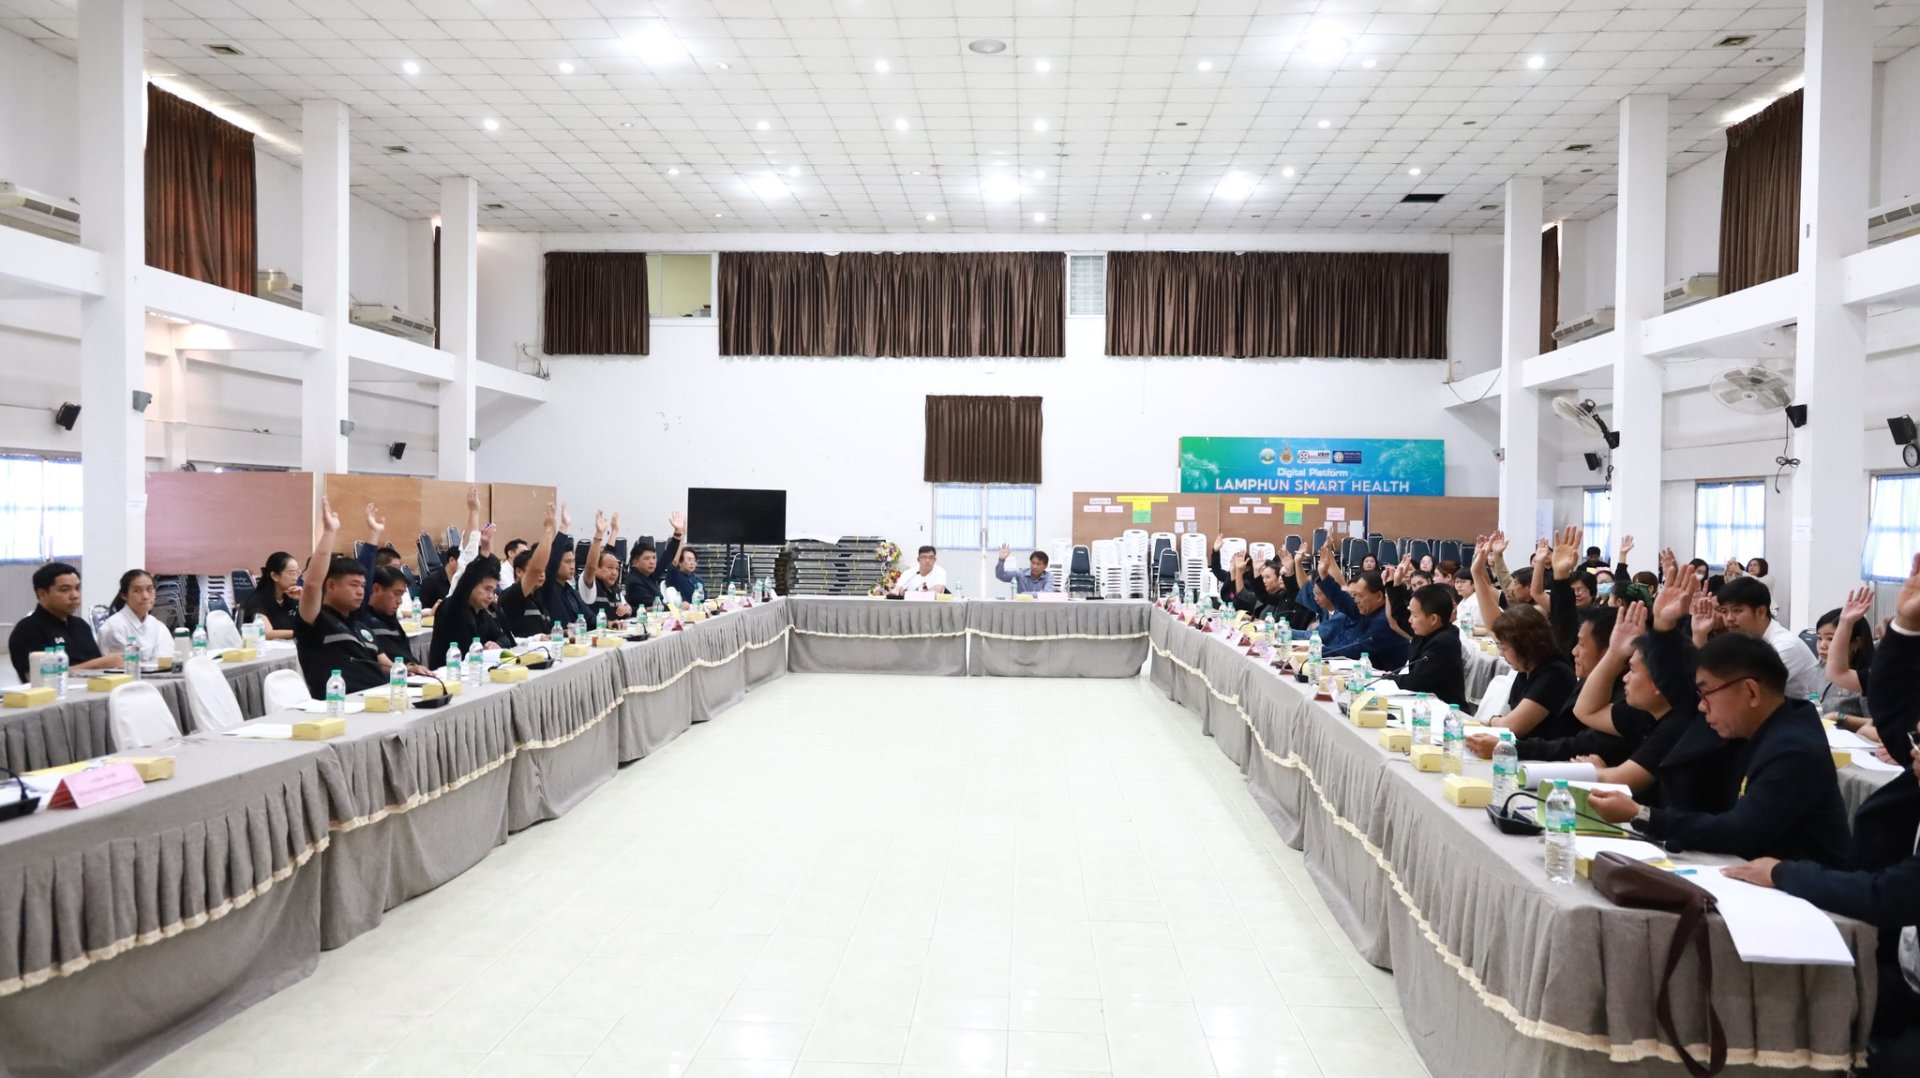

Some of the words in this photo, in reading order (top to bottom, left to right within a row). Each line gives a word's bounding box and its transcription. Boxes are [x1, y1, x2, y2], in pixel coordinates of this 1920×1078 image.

[1277, 467, 1306, 479] Digital
[1309, 467, 1349, 477] Platform
[1215, 479, 1290, 491] LAMPHUN
[1294, 480, 1347, 491] SMART
[1351, 480, 1410, 492] HEALTH
